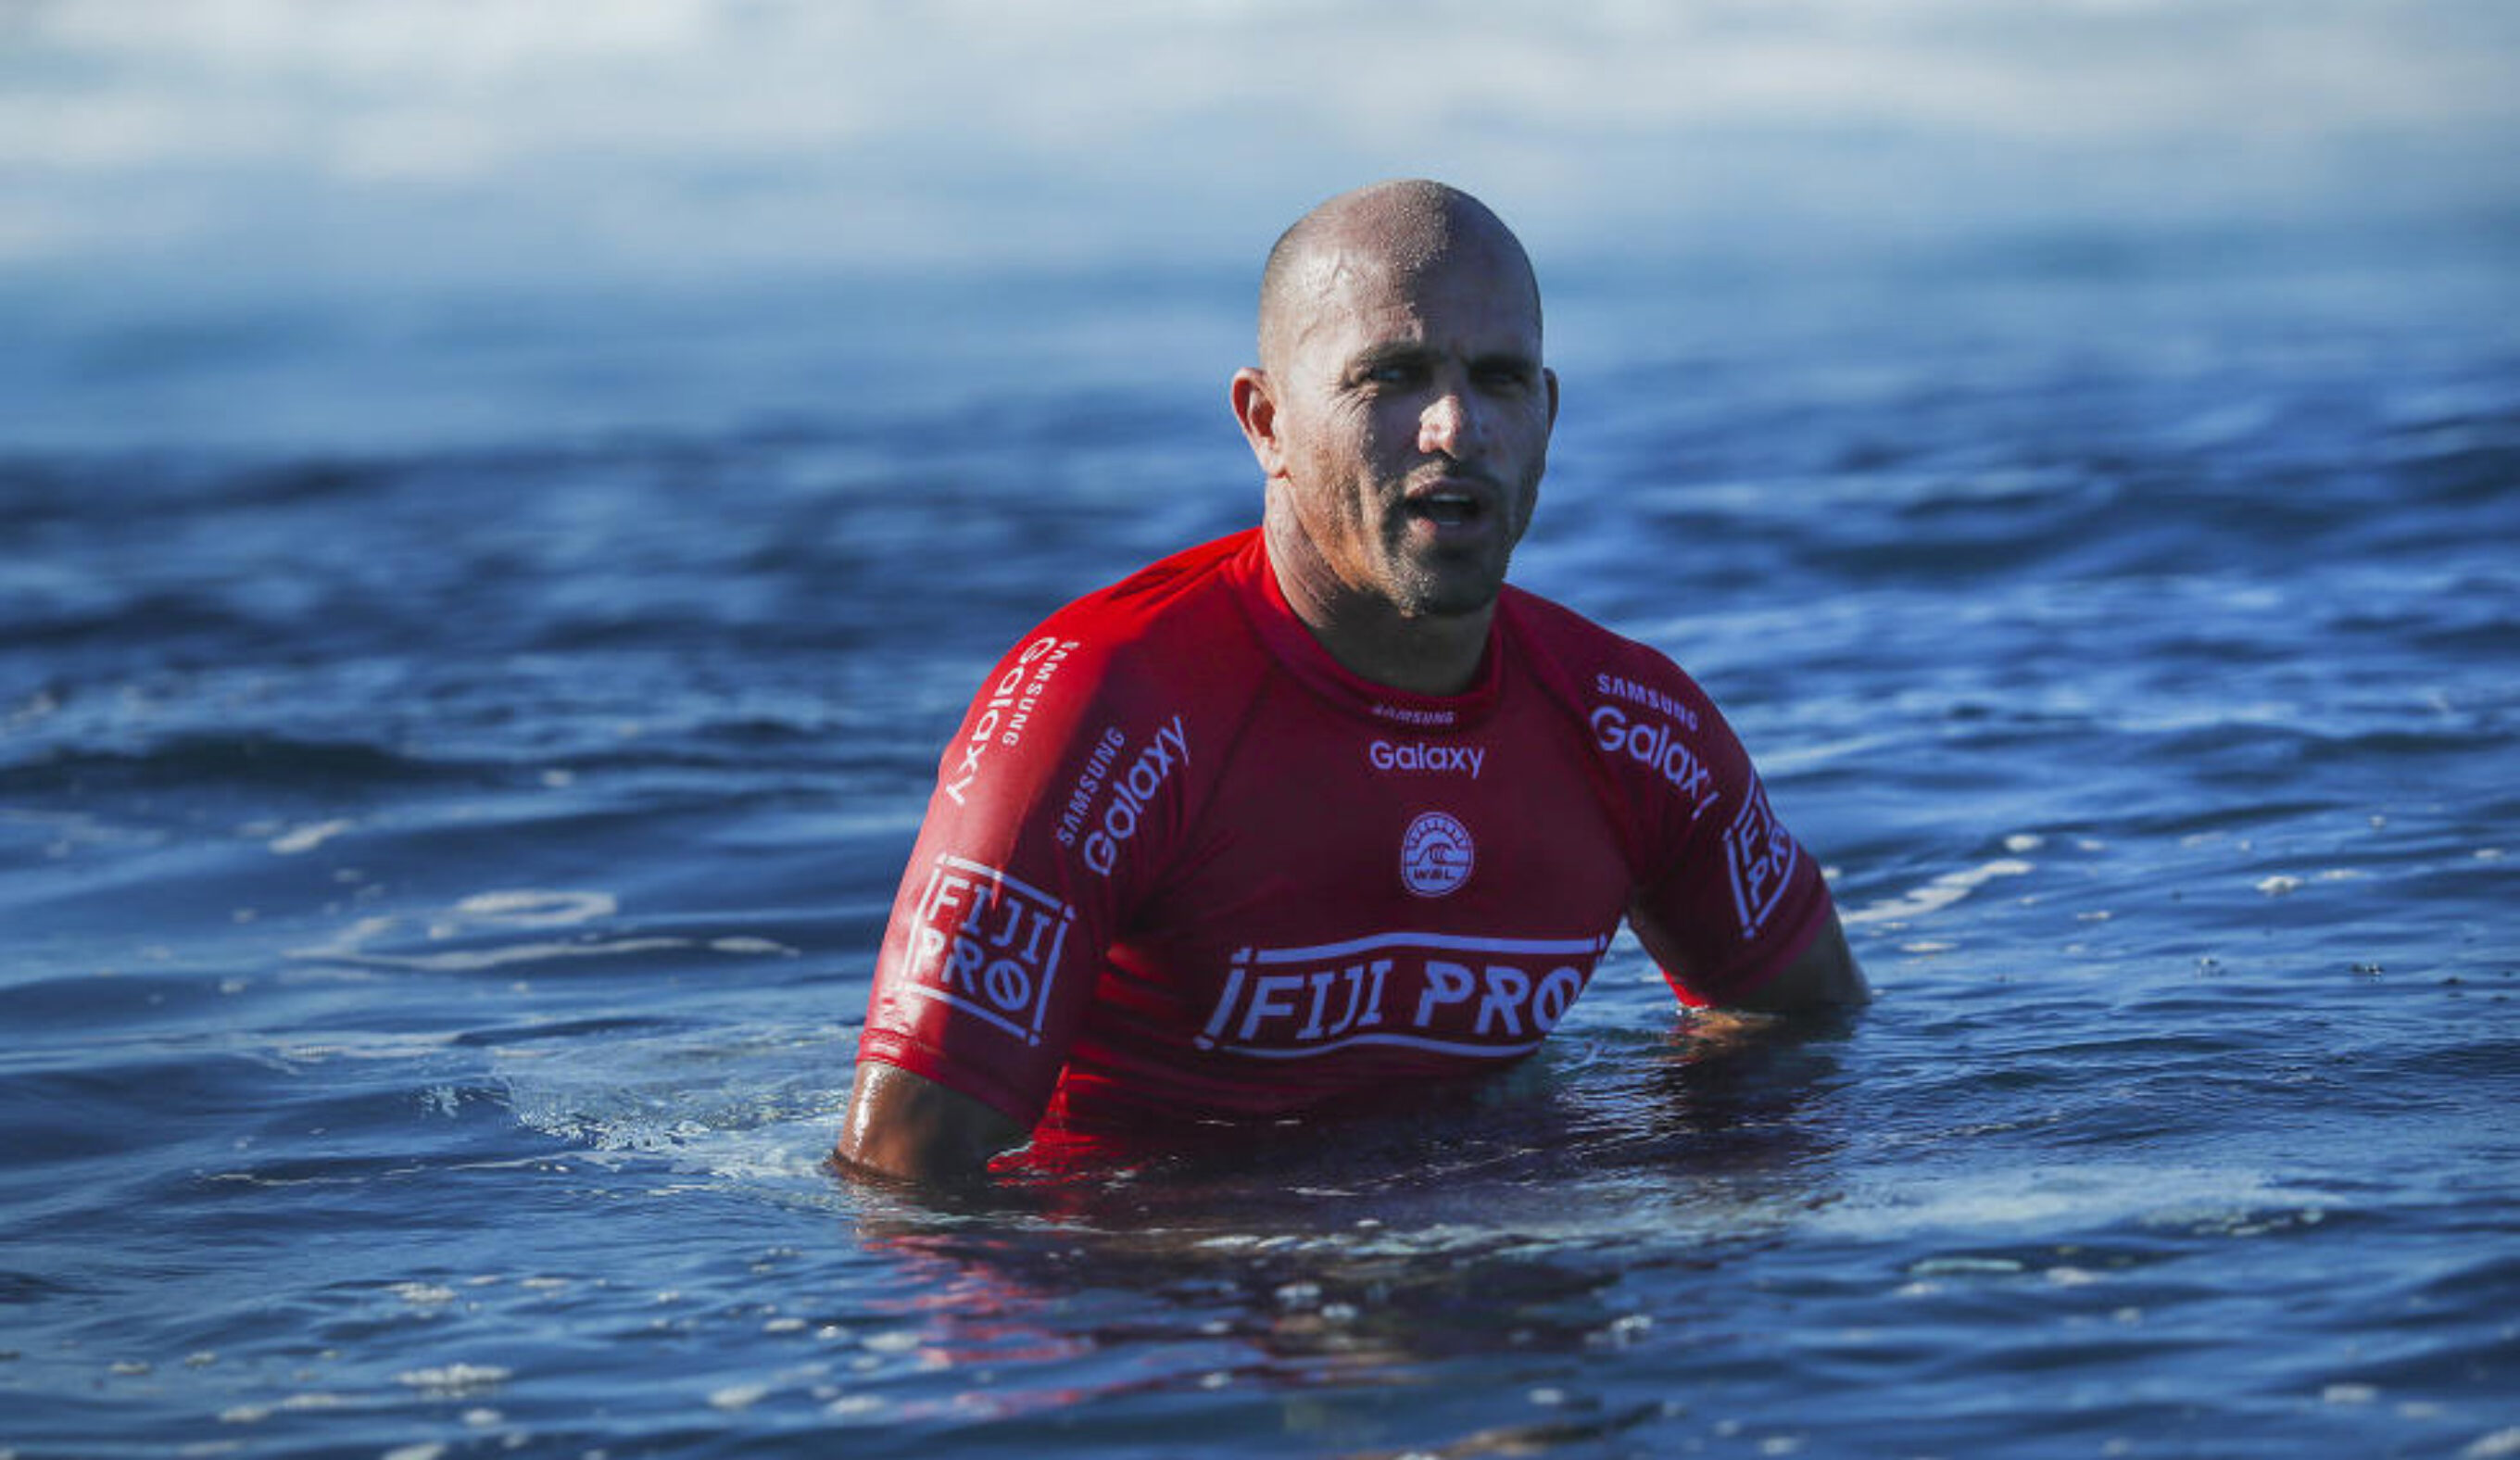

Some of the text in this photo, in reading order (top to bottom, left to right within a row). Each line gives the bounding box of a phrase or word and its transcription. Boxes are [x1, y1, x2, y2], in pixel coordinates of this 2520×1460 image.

[945, 636, 1057, 807] Galaxy
[1002, 640, 1080, 747] SAMSUNG
[1371, 702, 1455, 725] SAMSUNG
[1596, 673, 1699, 732] SAMSUNG
[1056, 726, 1125, 846] SAMSUNG
[1084, 715, 1190, 876] Galaxy
[1369, 739, 1485, 780] Galaxy
[1591, 705, 1720, 822] Galaxy
[926, 874, 1052, 965] FIJI
[913, 925, 1031, 1012] PRO
[1238, 959, 1581, 1040] FIJI PRO
